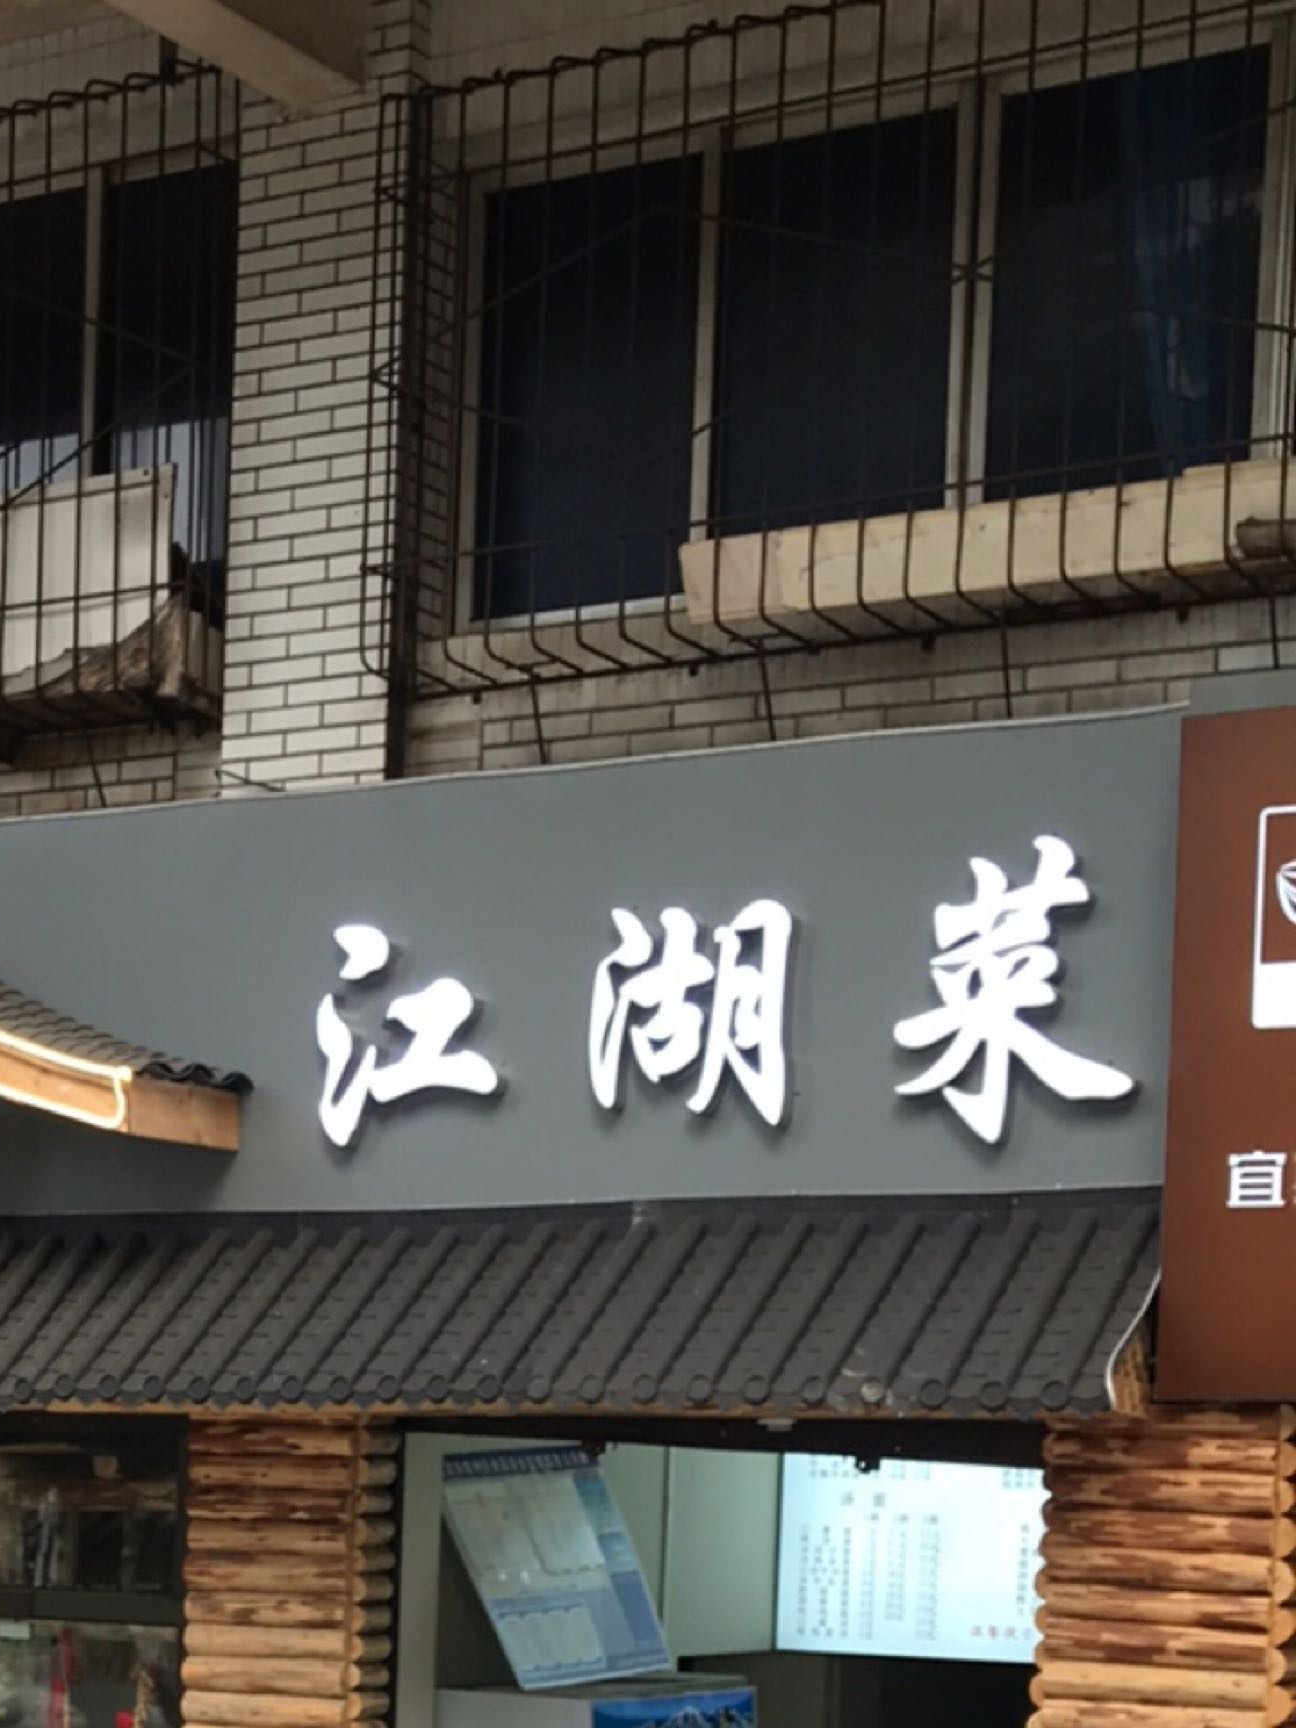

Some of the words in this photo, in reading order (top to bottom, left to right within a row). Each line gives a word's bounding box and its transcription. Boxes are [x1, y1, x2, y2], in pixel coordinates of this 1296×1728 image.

[317, 835, 1138, 1147] 江湖菜
[1226, 1149, 1296, 1208] 宜
